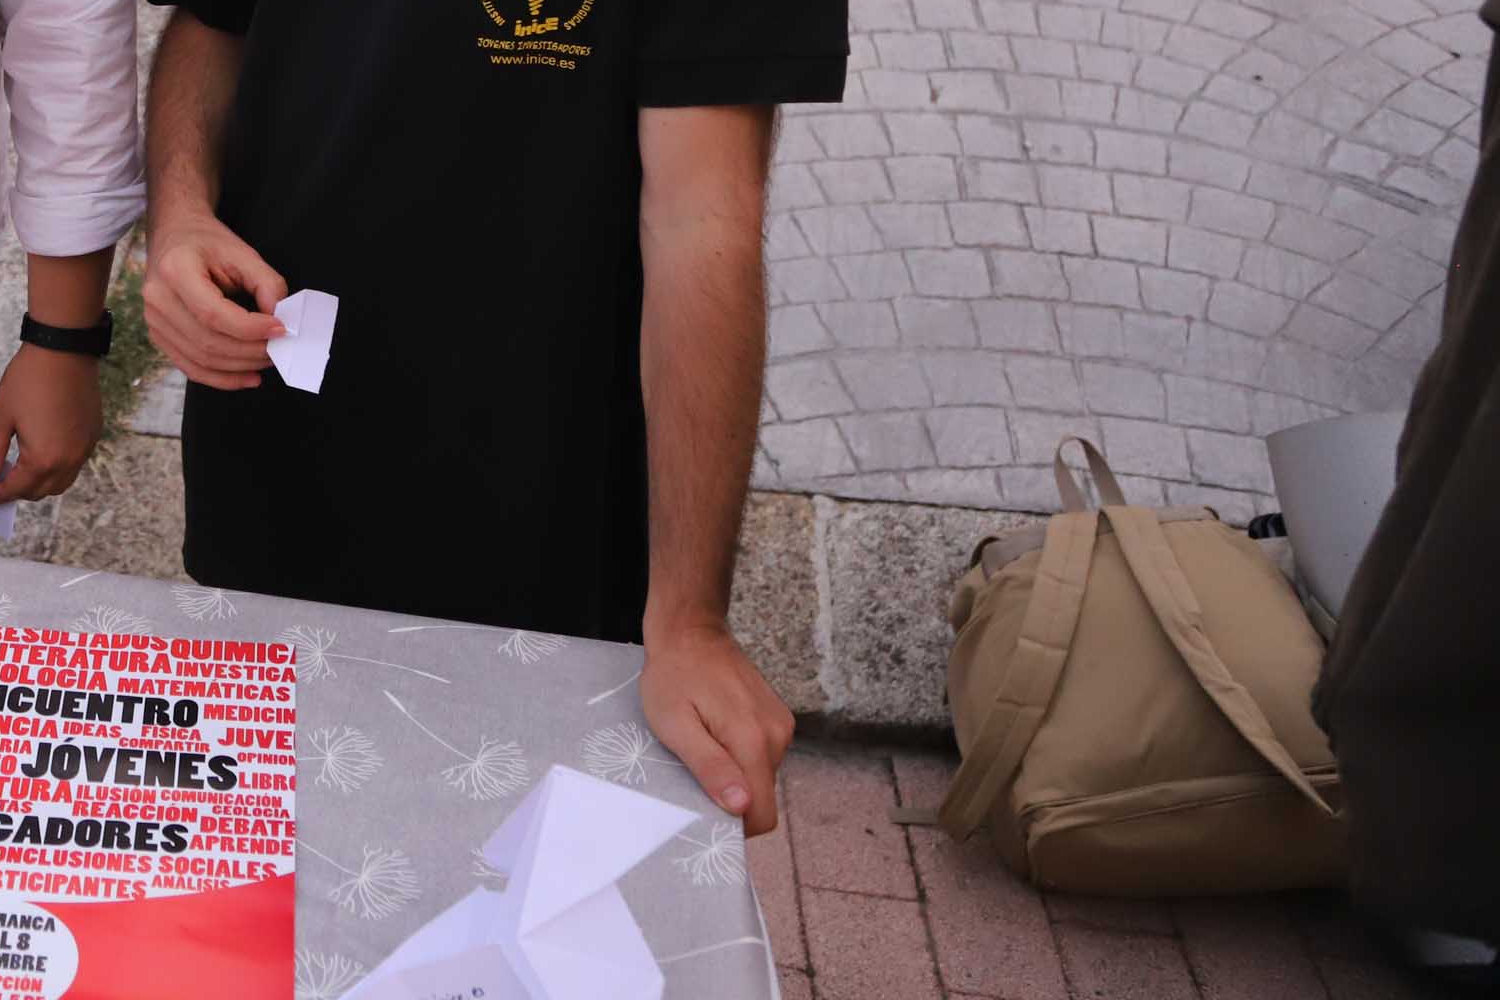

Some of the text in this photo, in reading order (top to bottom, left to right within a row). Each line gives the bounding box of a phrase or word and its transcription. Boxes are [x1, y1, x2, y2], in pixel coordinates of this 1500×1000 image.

[490, 53, 577, 71] www.inice.es
[117, 677, 291, 703] MATEMÁTICAS
[62, 721, 123, 739] IDEAS
[217, 727, 296, 751] JUVE
[118, 737, 212, 754] COMPARTIR
[20, 737, 238, 792] JÓVENES
[160, 789, 283, 809] COMUNICACIÓN
[72, 801, 199, 824] REACCIÓN
[188, 834, 294, 857] APRENDE
[158, 854, 278, 881] SOCIALES
[16, 932, 32, 951] 8
